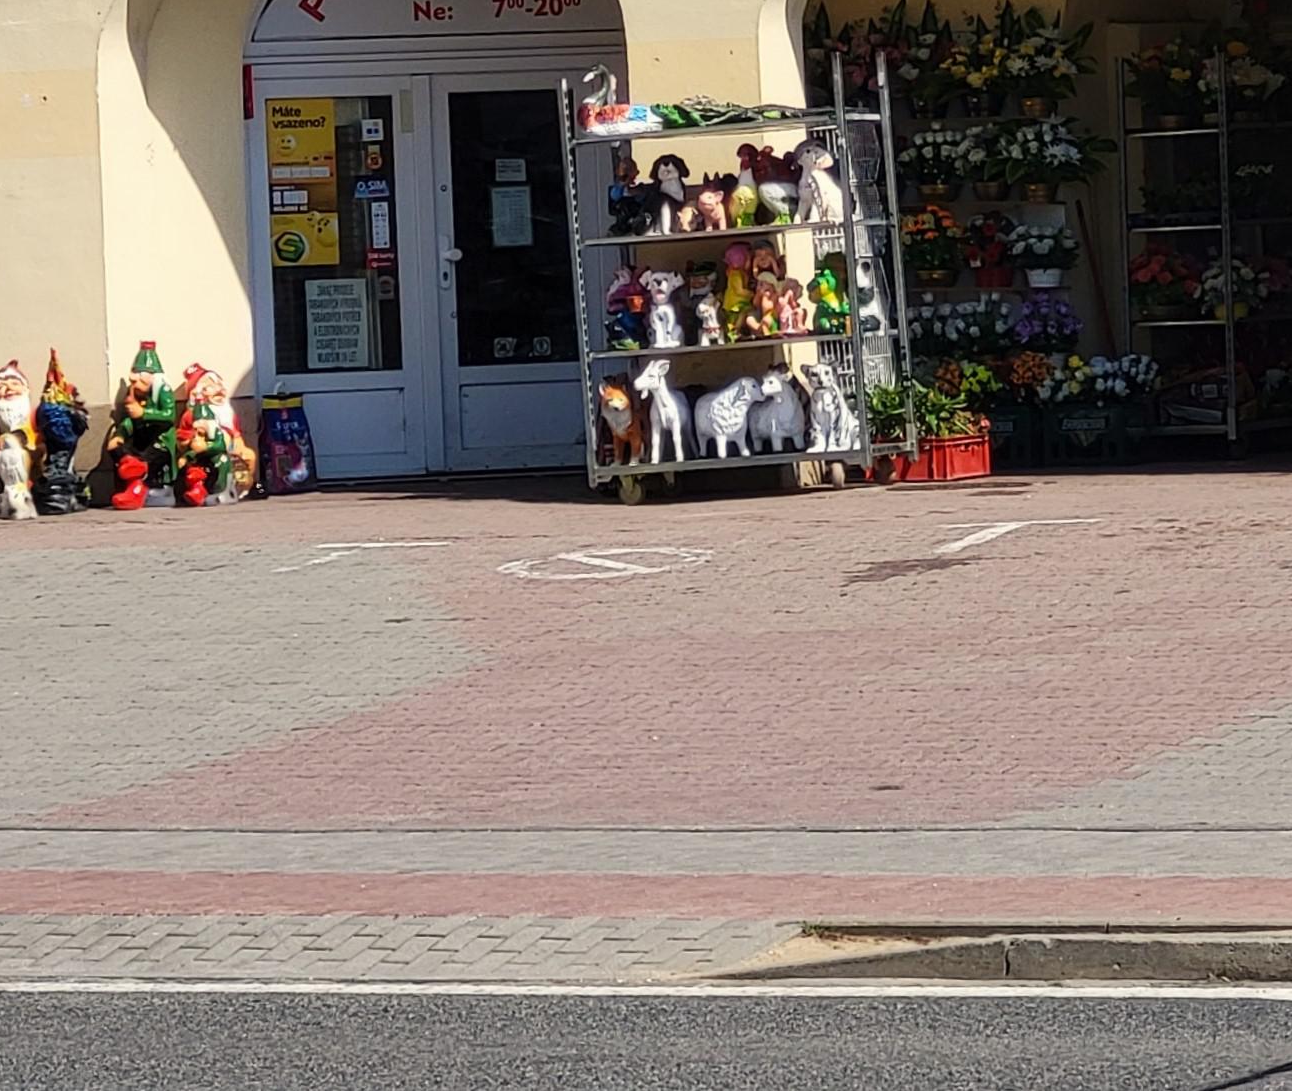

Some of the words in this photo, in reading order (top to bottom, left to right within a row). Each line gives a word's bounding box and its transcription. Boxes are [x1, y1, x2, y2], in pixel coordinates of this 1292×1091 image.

[414, 1, 453, 21] Ne:
[272, 106, 302, 118] Máte
[272, 116, 326, 129] vsazeno?
